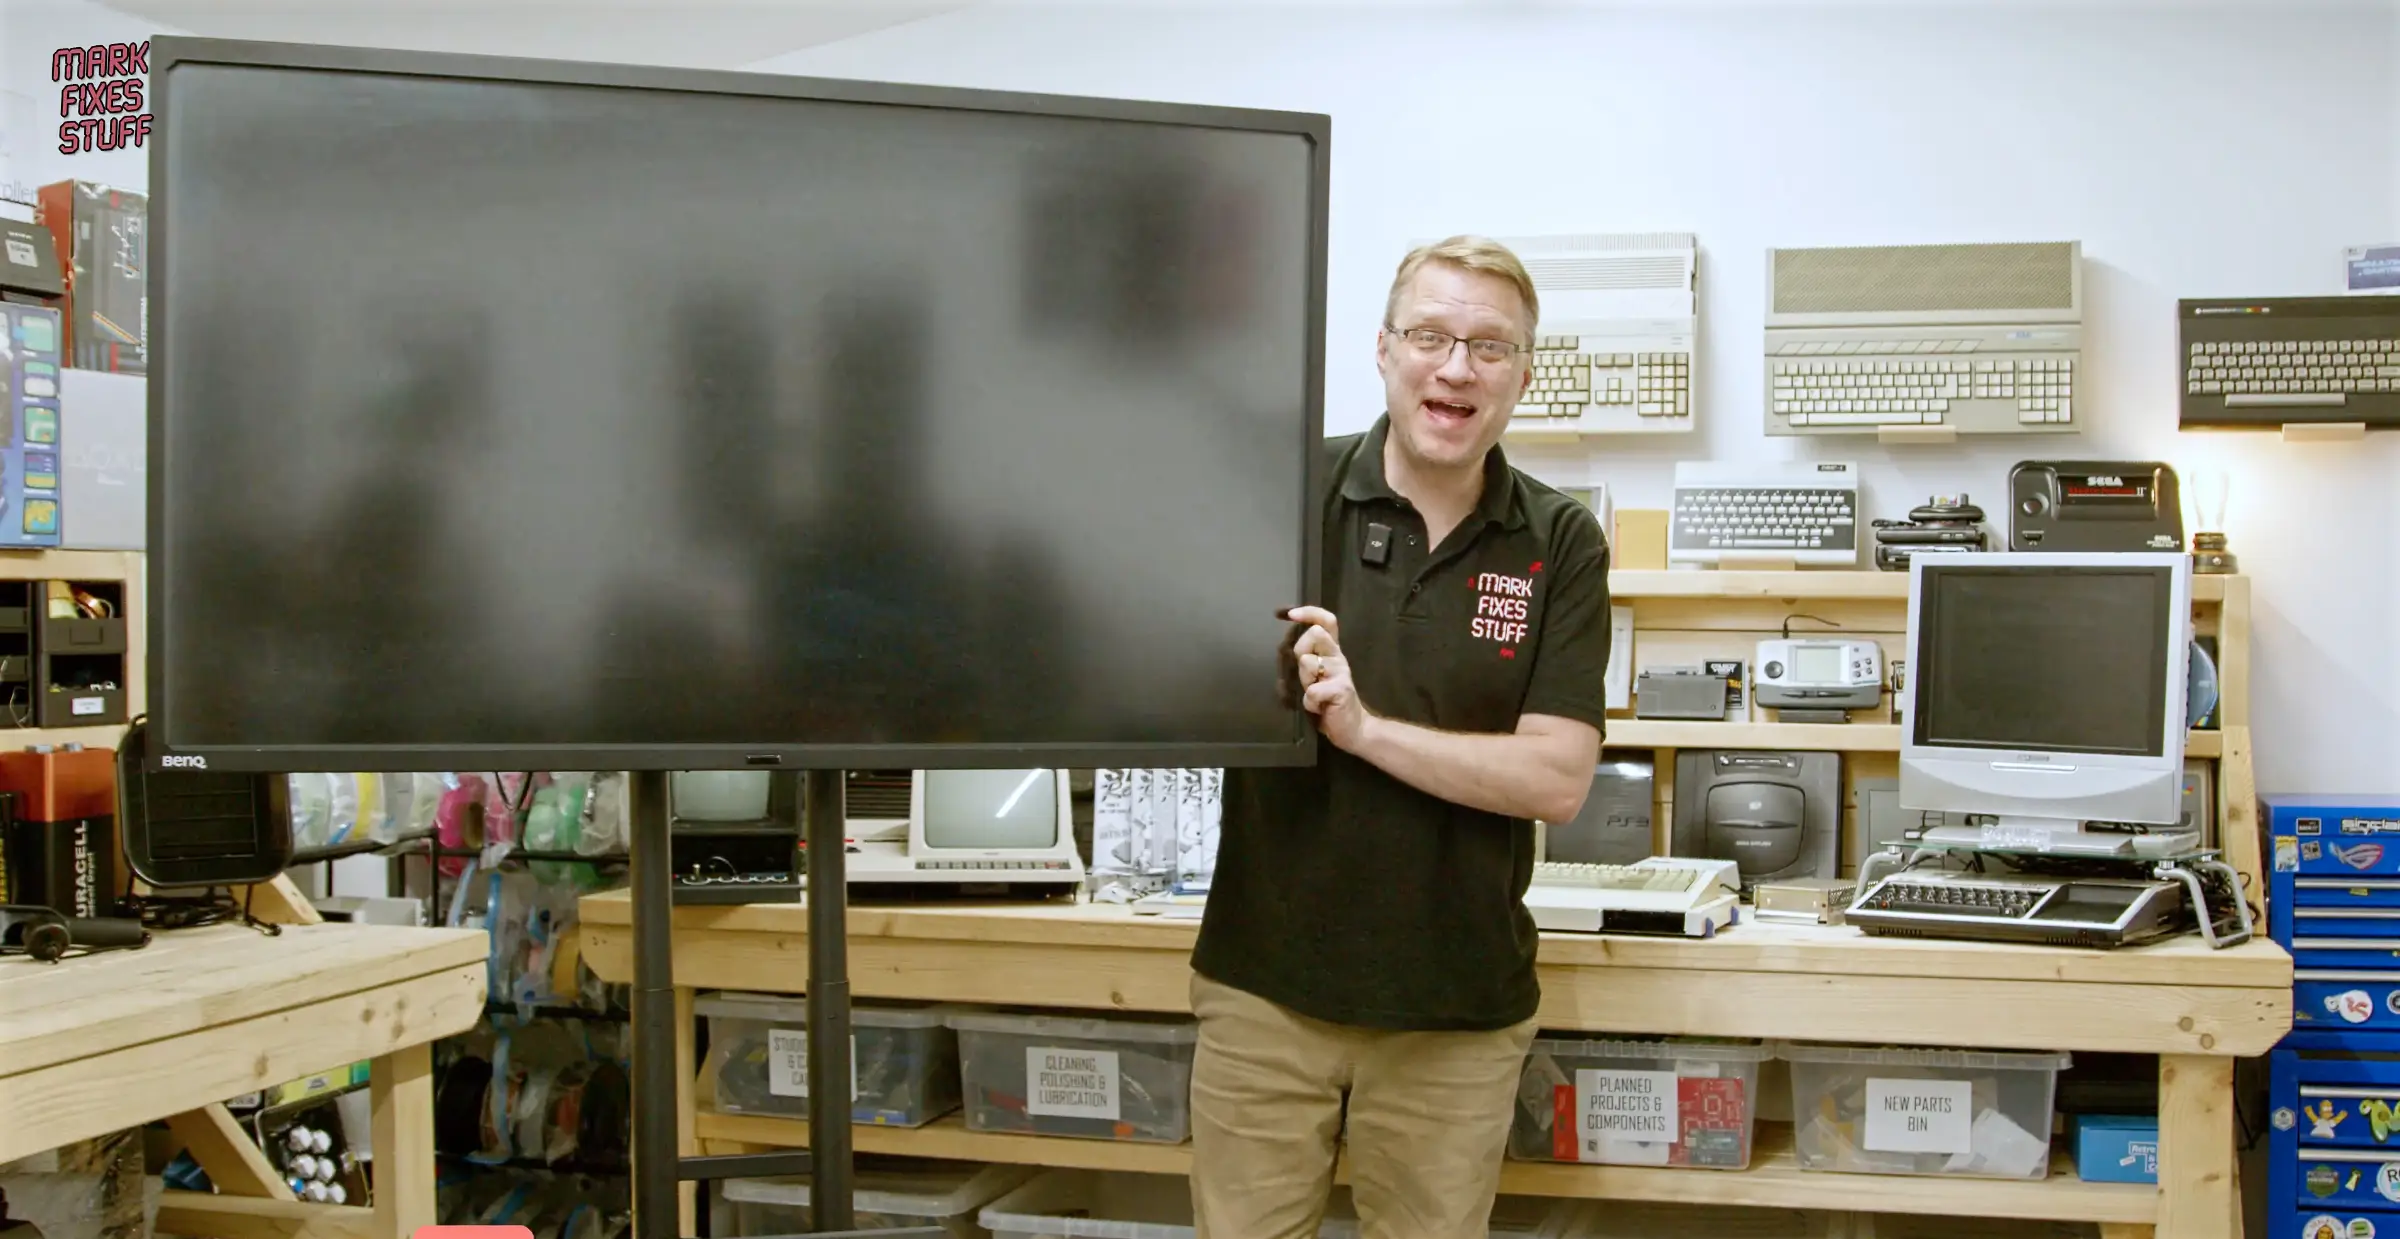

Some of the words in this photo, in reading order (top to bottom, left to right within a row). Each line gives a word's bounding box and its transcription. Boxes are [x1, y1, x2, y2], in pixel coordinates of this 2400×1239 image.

[2087, 476, 2123, 487] SEGA
[1478, 573, 1533, 597] MARK
[1477, 596, 1528, 620] FIXES
[1471, 618, 1528, 643] STUFF
[1606, 815, 1650, 828] PS3
[75, 820, 89, 918] URACELL
[1040, 1072, 1095, 1089] POLISHING
[1099, 1075, 1106, 1090] &
[1600, 1077, 1652, 1094] PLANNED
[1039, 1090, 1107, 1107] LUBRICATION
[1591, 1095, 1650, 1112] PROJECTS
[1654, 1096, 1662, 1112] &
[1884, 1096, 1910, 1112] NEW
[1914, 1096, 1952, 1113] PARTS
[1587, 1114, 1665, 1131] COMPONENTS
[1907, 1116, 1928, 1132] BIN
